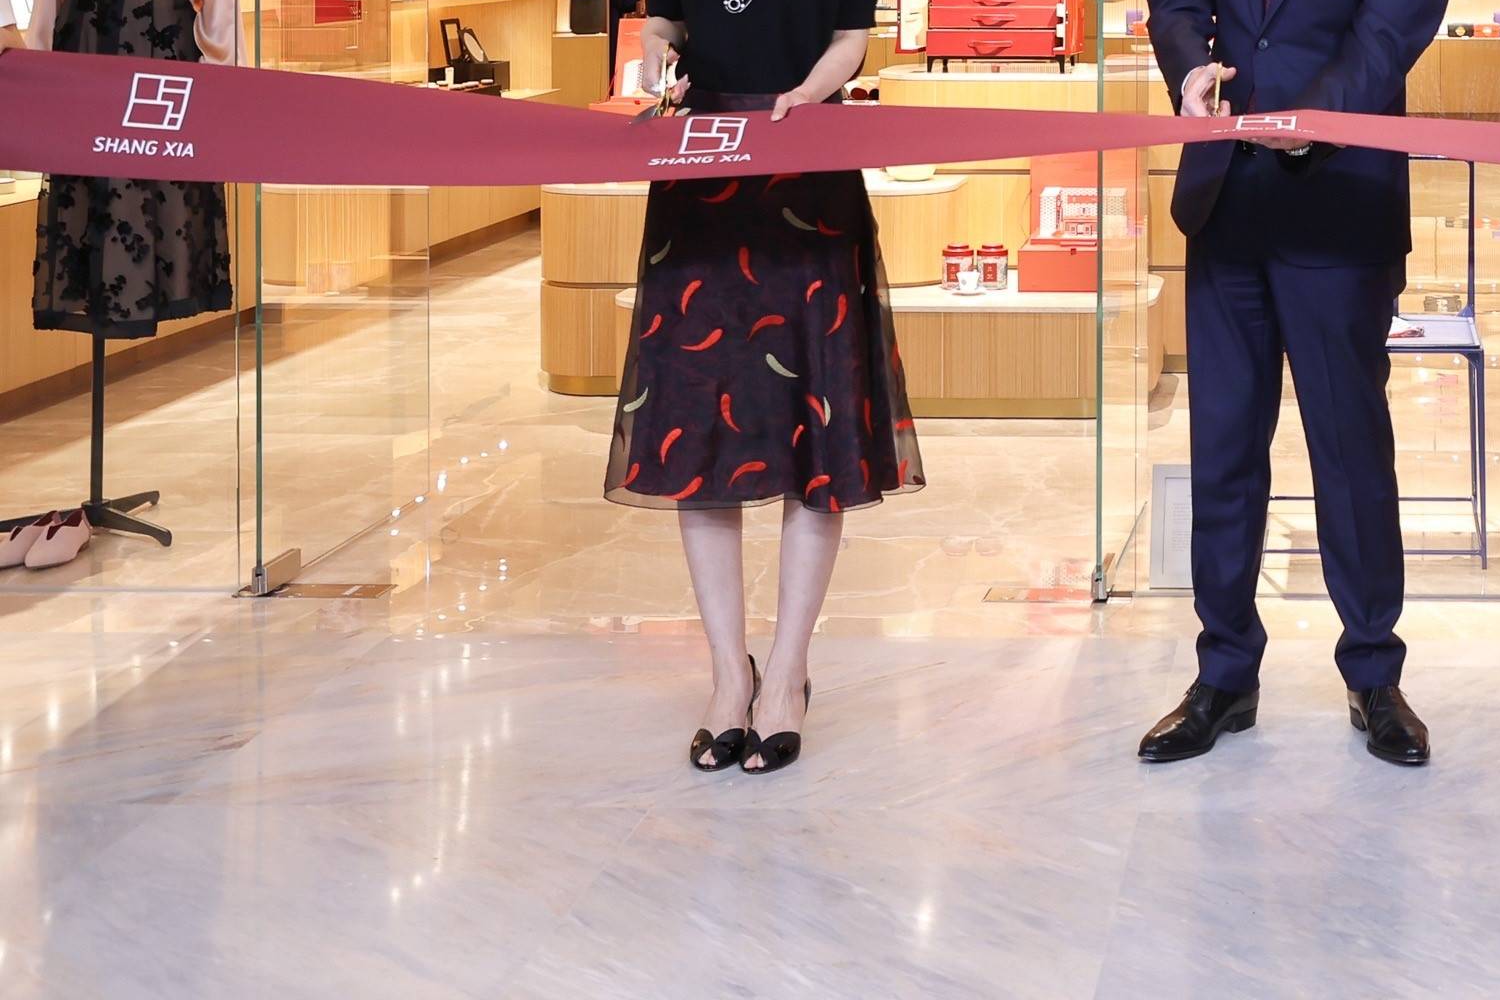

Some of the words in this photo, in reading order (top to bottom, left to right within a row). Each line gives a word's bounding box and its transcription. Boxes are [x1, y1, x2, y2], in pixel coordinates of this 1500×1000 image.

[93, 136, 158, 156] SHANG
[162, 141, 194, 158] XIA
[648, 155, 715, 166] SHANG
[719, 153, 752, 163] XIA
